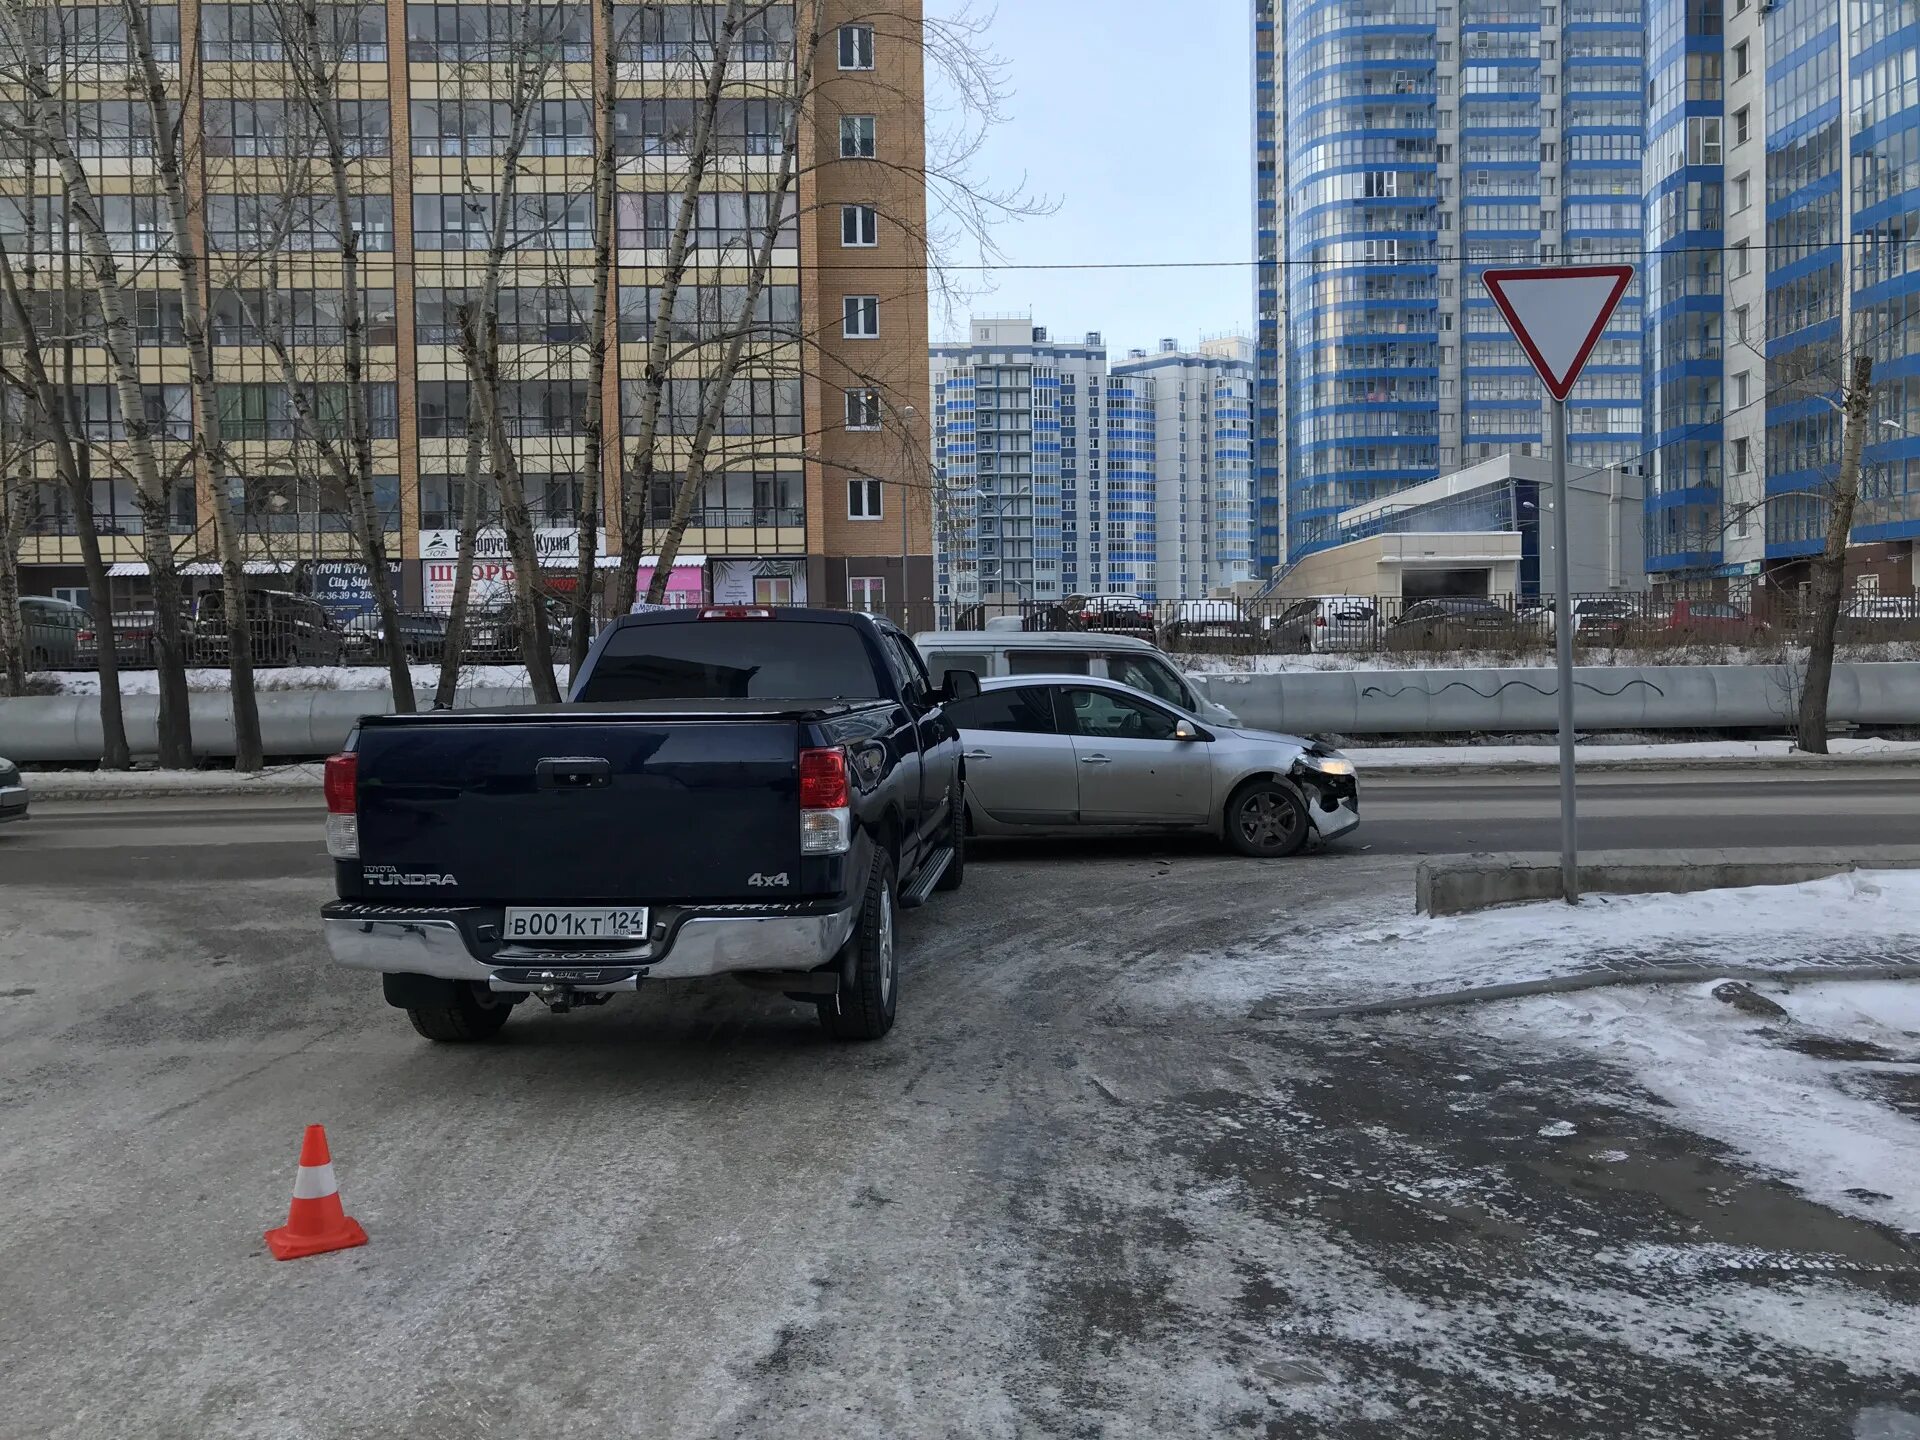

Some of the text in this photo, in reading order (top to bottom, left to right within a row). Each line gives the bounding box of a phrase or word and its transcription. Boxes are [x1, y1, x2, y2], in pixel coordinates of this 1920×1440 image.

[535, 534, 570, 553] Кухни
[343, 562, 402, 575] КРАТЫ
[429, 564, 517, 581] ШОРЫ
[328, 576, 349, 590] City
[363, 865, 397, 873] TOYOTA
[363, 873, 459, 886] TUNDRA
[613, 928, 632, 936] RUS
